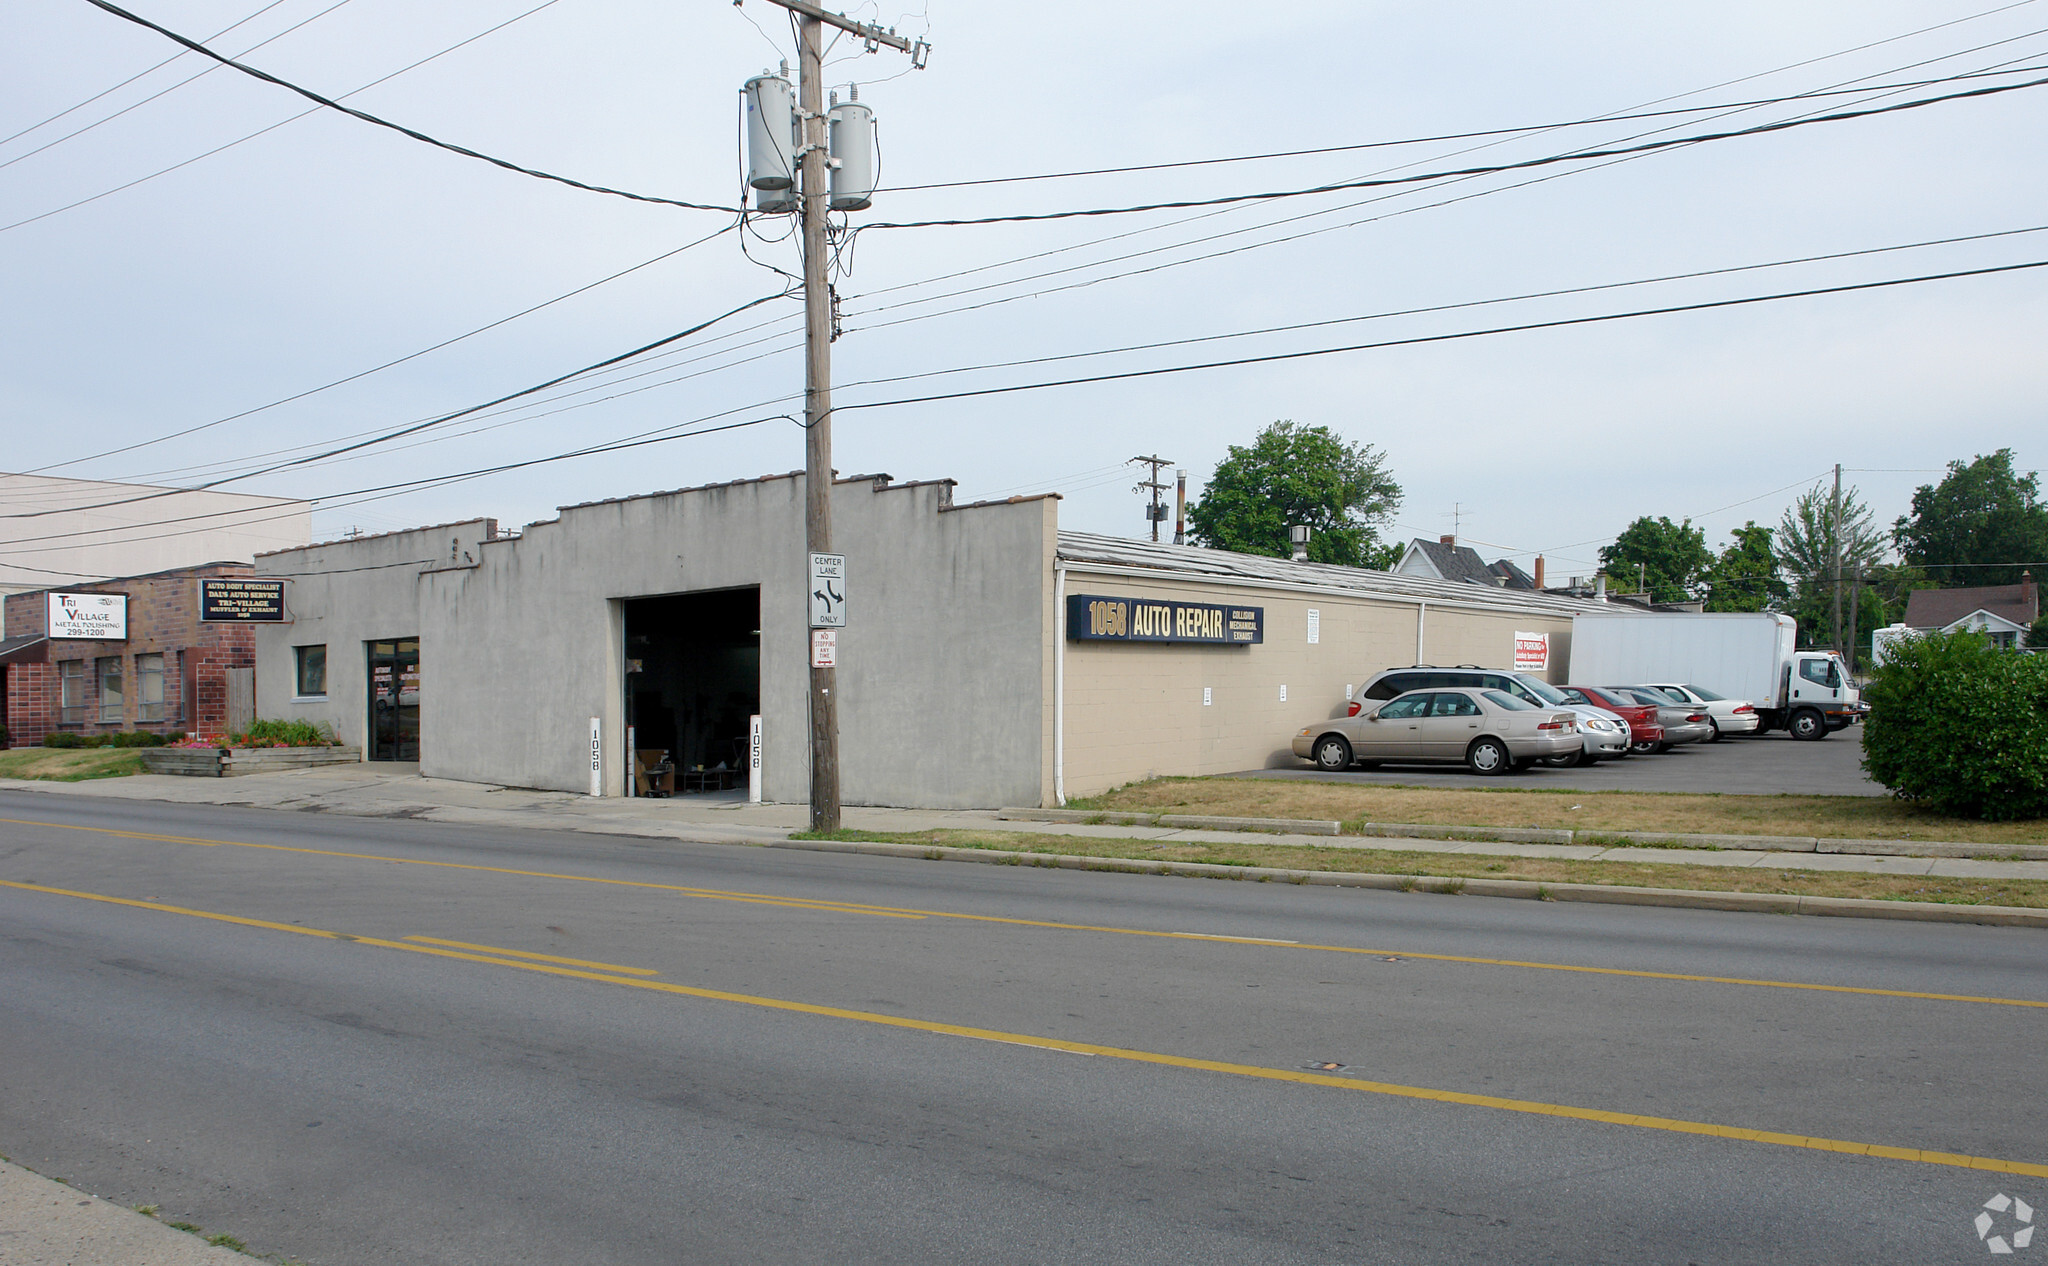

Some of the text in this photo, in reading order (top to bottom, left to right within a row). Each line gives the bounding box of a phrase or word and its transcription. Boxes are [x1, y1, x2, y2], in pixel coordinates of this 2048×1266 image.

[814, 557, 842, 566] CENTER
[820, 567, 837, 575] LANE
[820, 615, 838, 624] ONLY
[1089, 601, 1127, 637] 1058
[1232, 610, 1255, 620] COLLISION
[1133, 604, 1223, 638] AUTO REPAIR
[1229, 620, 1257, 630] MECHANICAL
[67, 628, 105, 636] 299-1200
[1233, 631, 1253, 640] EXHAUST
[815, 640, 836, 648] STOPPING
[1524, 641, 1541, 651] PARKING
[752, 723, 760, 768] 1058
